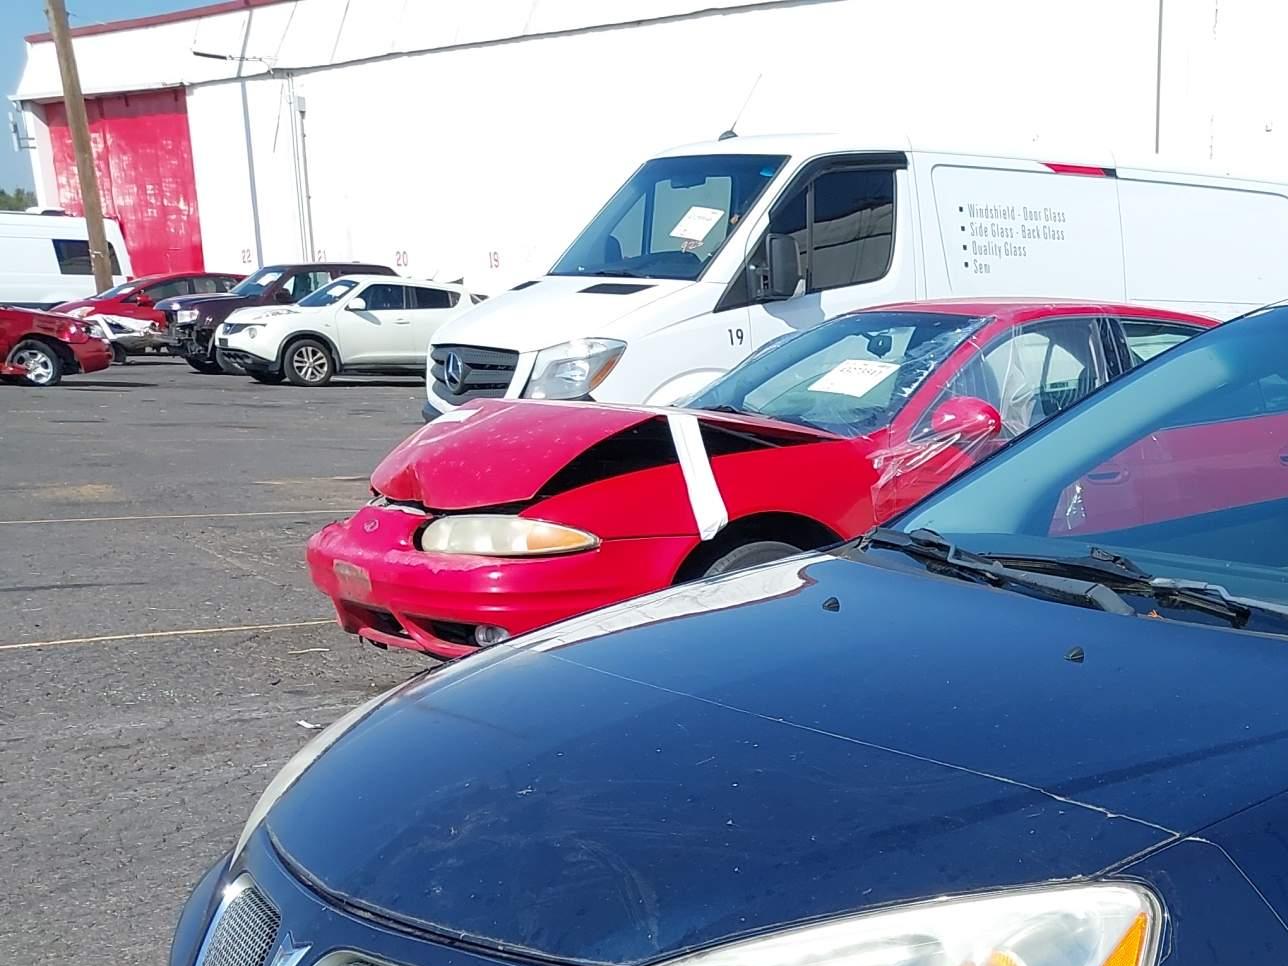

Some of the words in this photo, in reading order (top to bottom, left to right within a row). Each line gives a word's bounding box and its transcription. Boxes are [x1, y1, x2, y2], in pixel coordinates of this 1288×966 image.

[967, 203, 1015, 221] Windshield
[1022, 206, 1041, 221] Door
[1043, 208, 1066, 223] Glass
[970, 222, 988, 238] Side
[991, 223, 1014, 239] Glass
[1021, 224, 1041, 239] Back
[1043, 225, 1065, 241] Glass
[242, 249, 252, 263] 22
[396, 250, 408, 267] 20
[971, 240, 1001, 259] Quality
[1004, 241, 1027, 257] Glass
[489, 251, 500, 268] 19
[728, 328, 744, 346] 19
